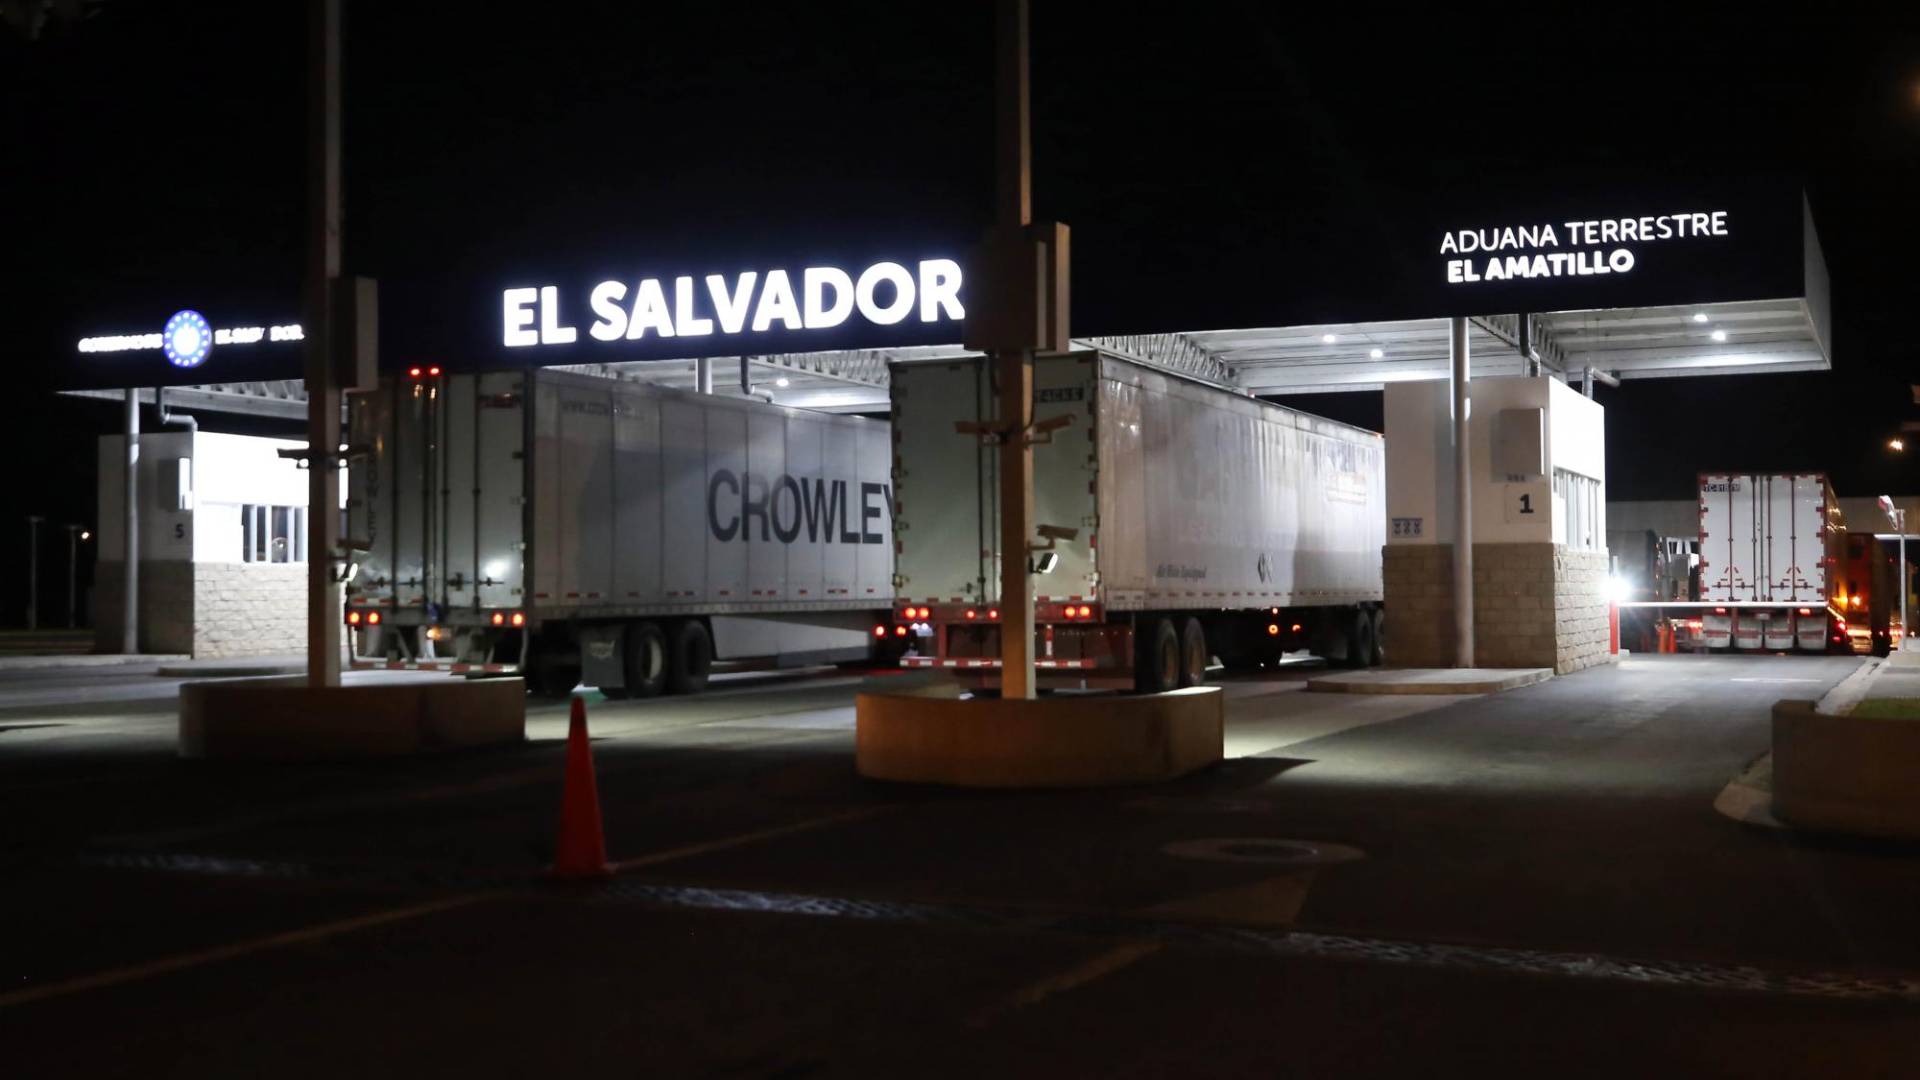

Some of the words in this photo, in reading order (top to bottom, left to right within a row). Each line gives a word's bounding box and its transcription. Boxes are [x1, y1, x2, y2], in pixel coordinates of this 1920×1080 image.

[1440, 224, 1559, 254] ADUANA
[1564, 211, 1729, 245] TERRESTRE
[1447, 259, 1481, 283] EL
[1484, 248, 1635, 280] AMATILLO
[503, 285, 577, 347] EL
[589, 258, 966, 341] SALVADOR
[1519, 493, 1534, 514] 1
